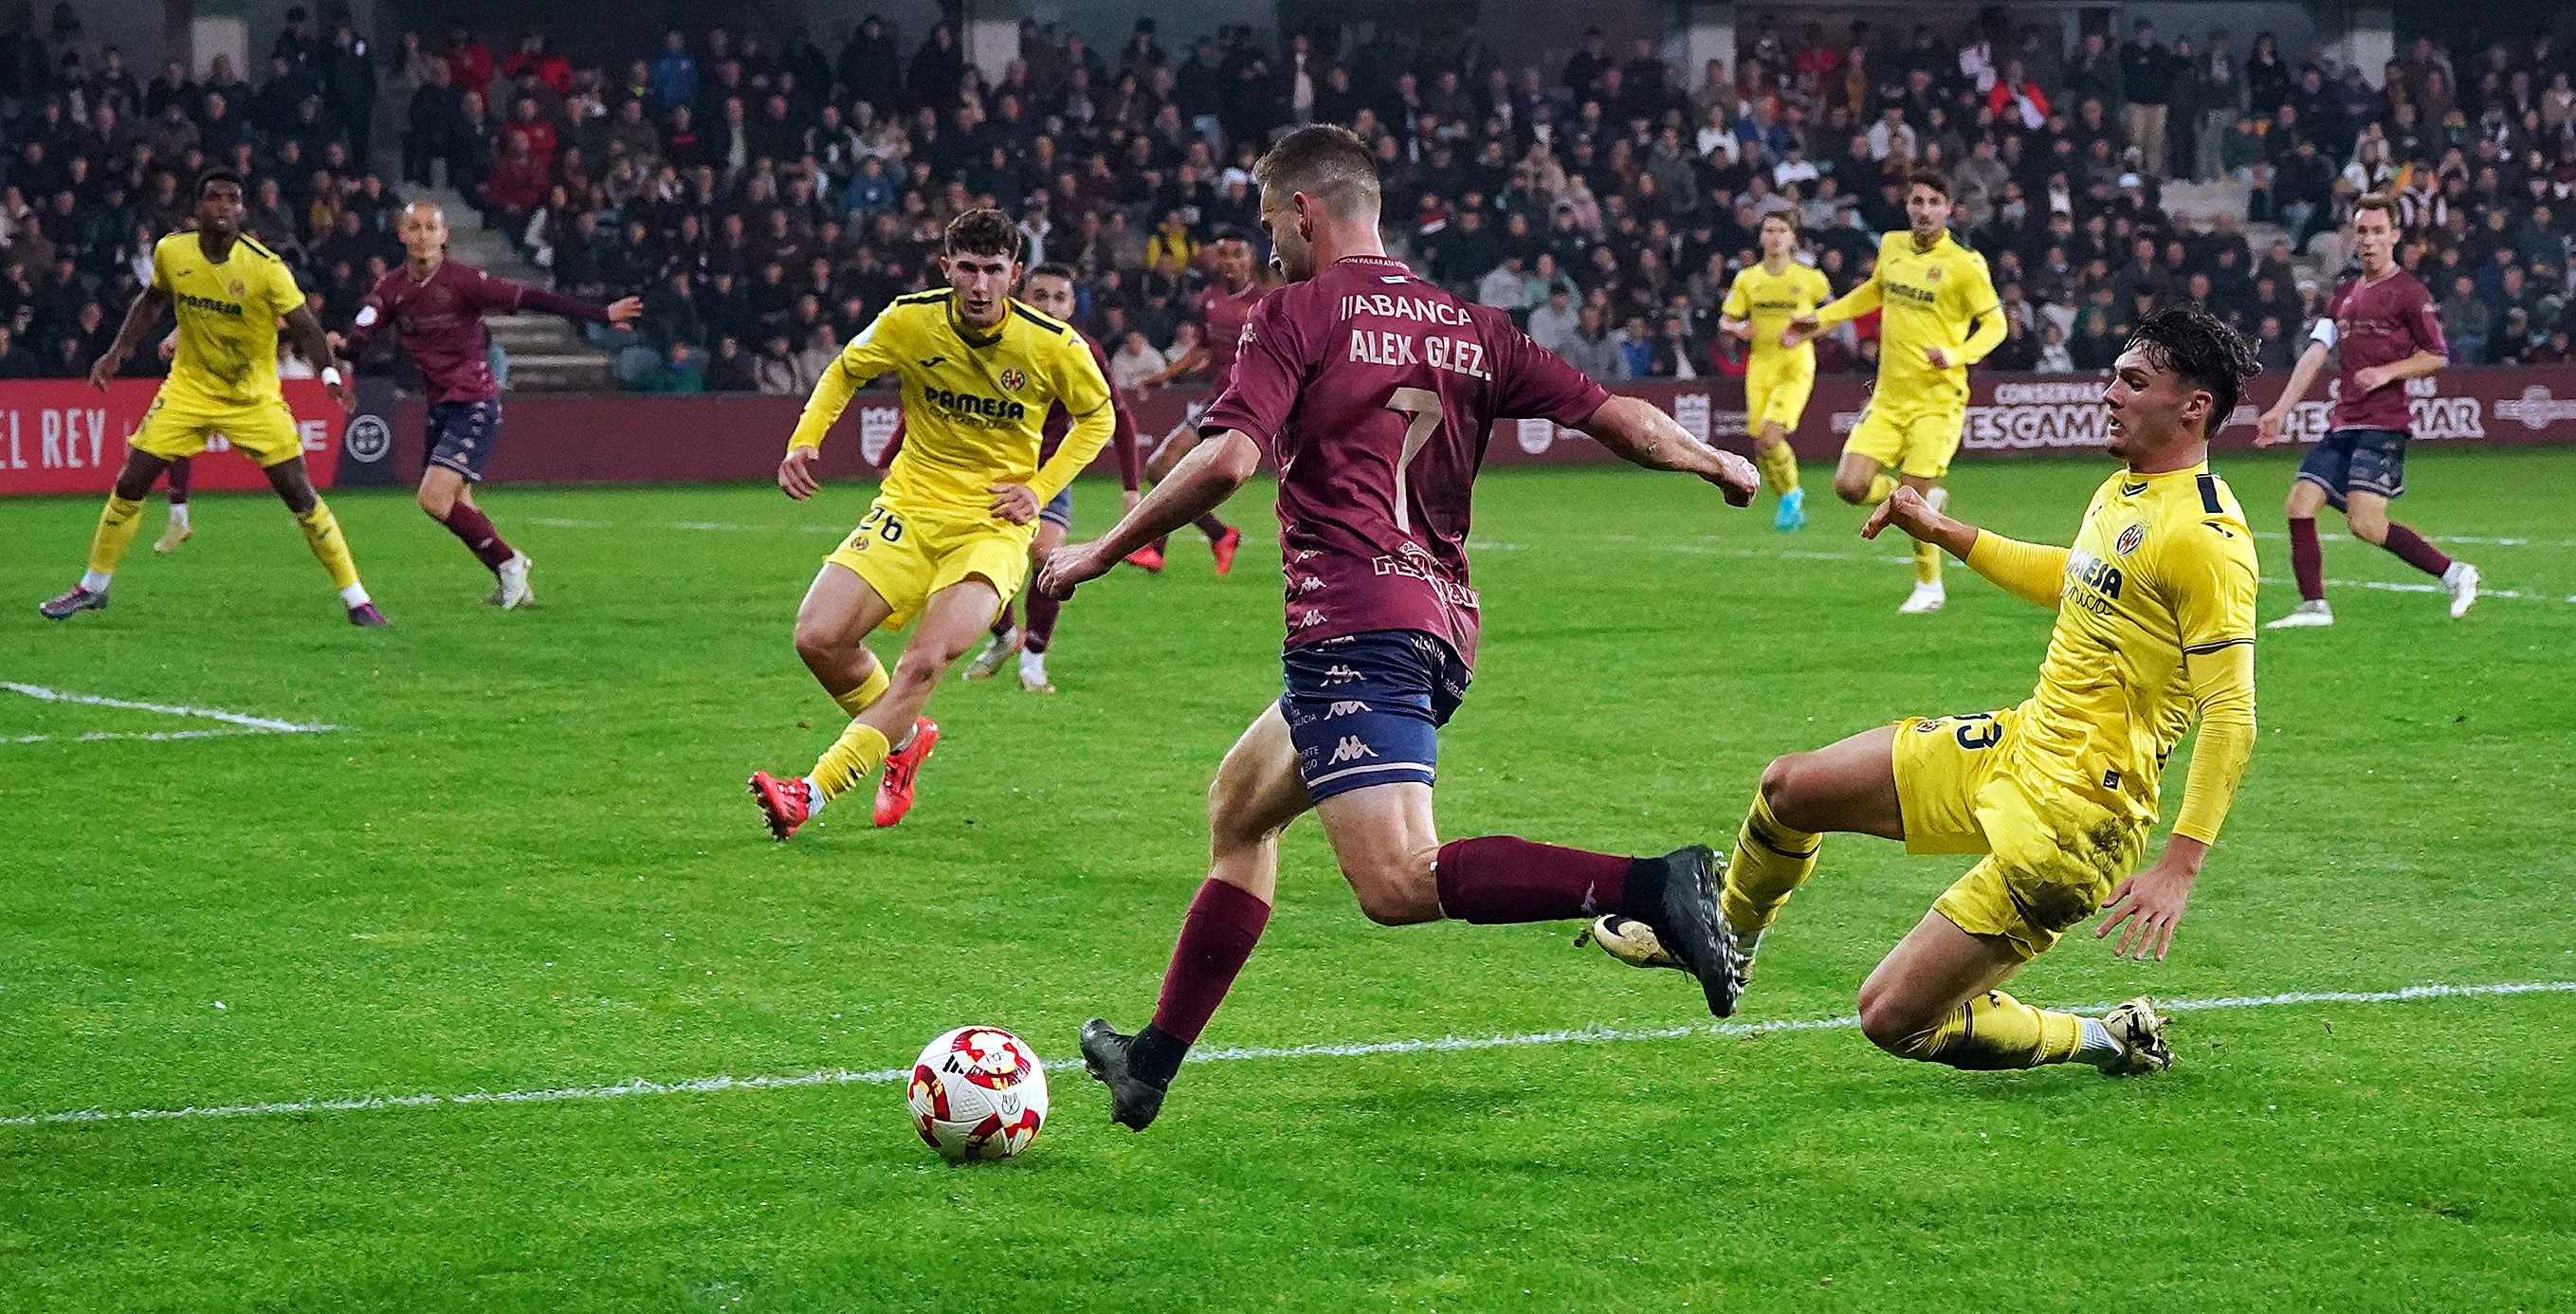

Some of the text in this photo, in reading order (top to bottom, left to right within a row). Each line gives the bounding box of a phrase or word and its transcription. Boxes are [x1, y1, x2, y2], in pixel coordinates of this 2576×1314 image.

[1349, 329, 1492, 381] ALEX GLEZ.
[924, 386, 1025, 420] PAMESA
[41, 408, 105, 469] REY
[1384, 387, 1444, 536] 7
[860, 506, 903, 542] 26
[1953, 713, 2002, 750] 3
